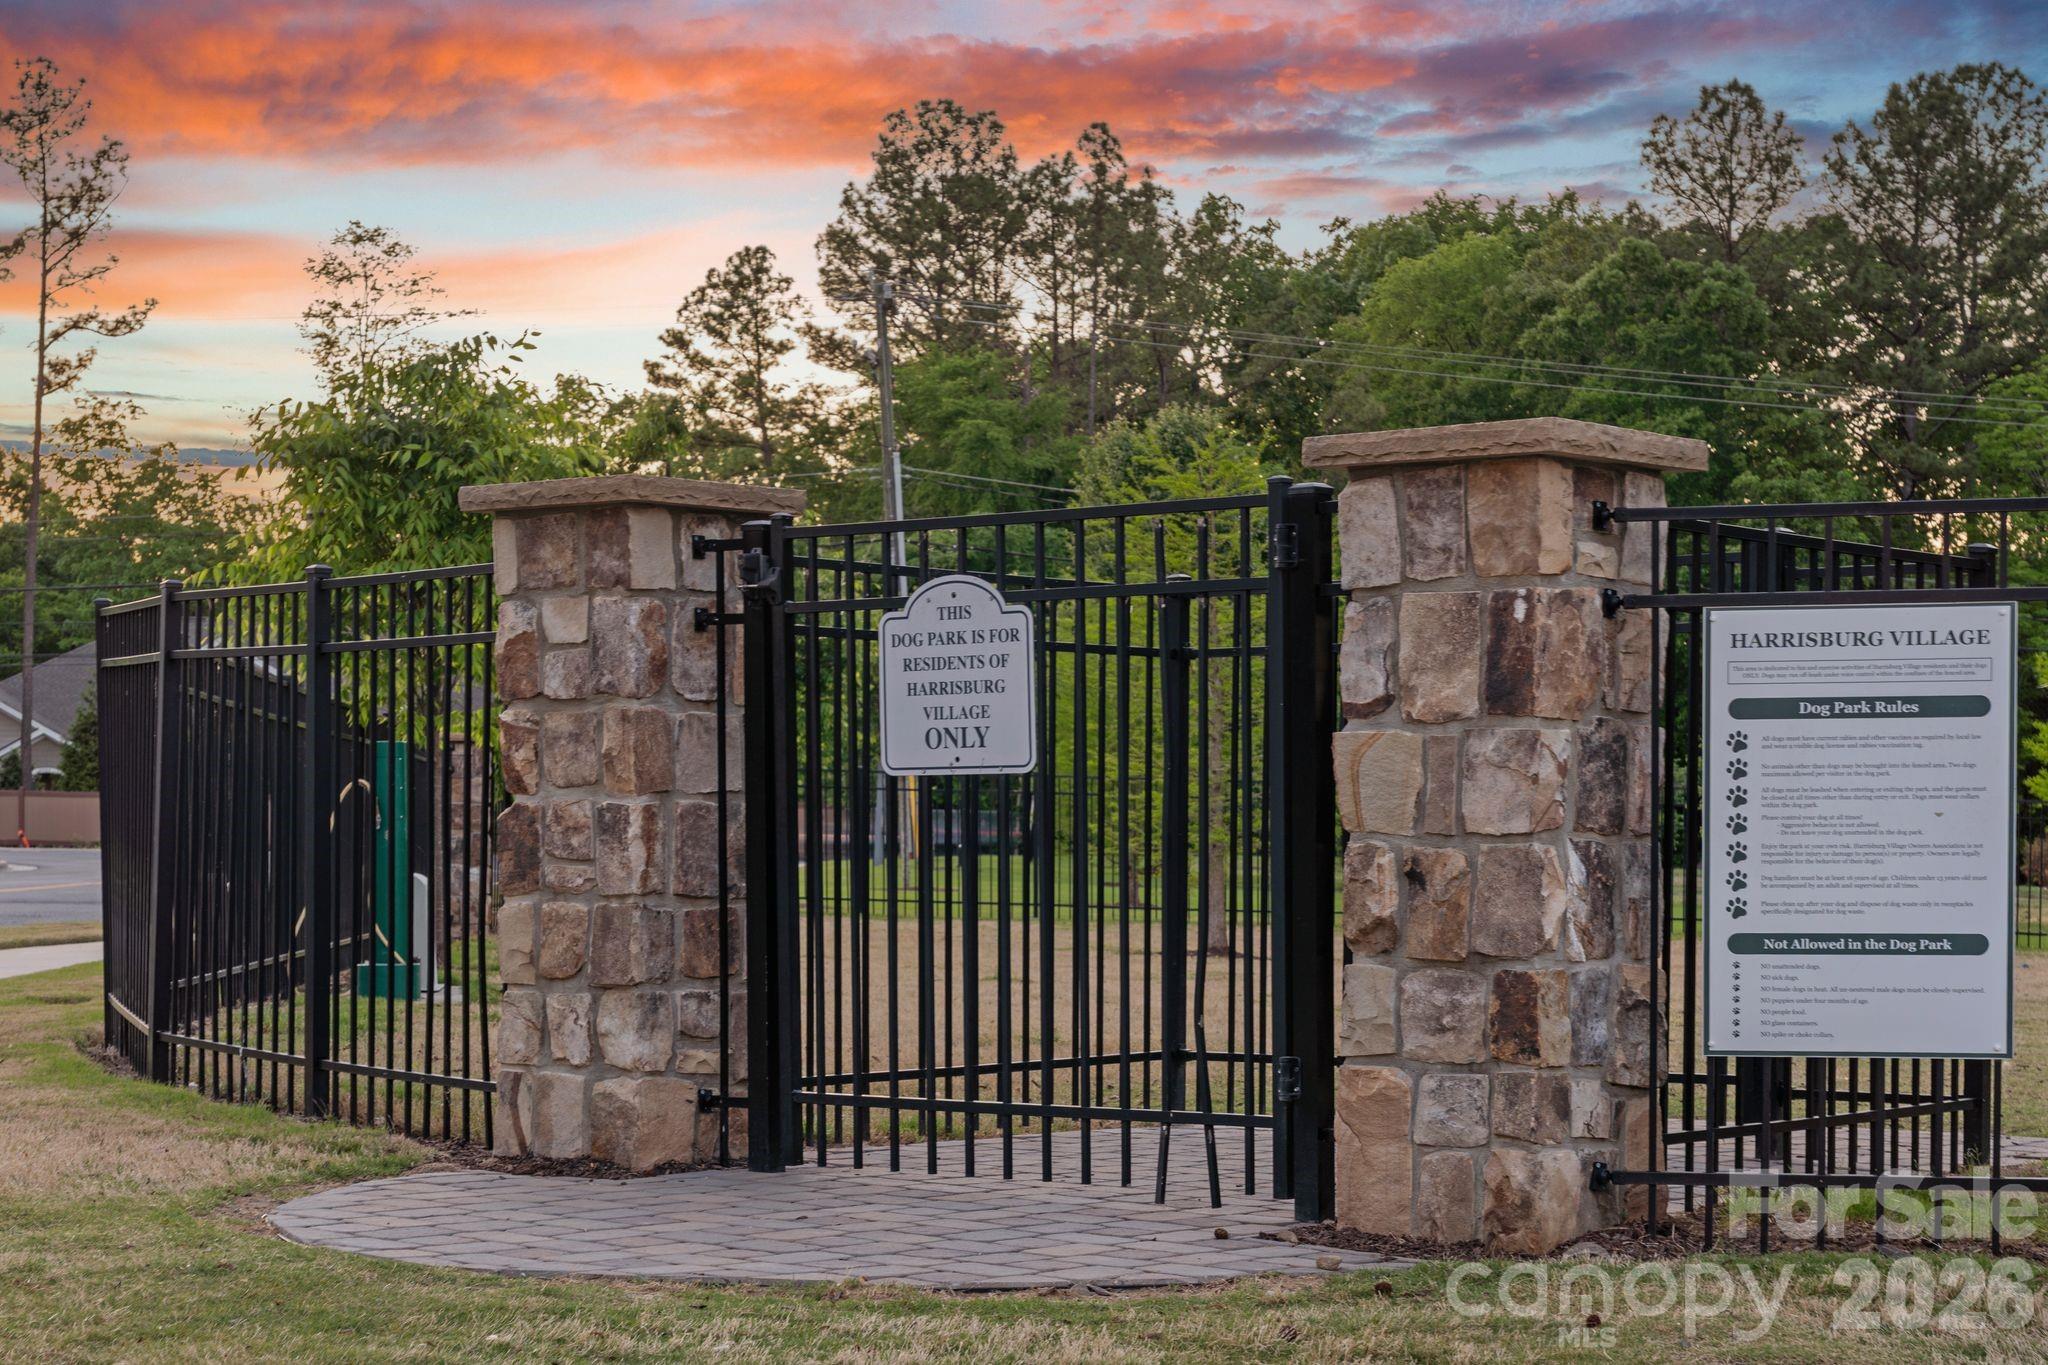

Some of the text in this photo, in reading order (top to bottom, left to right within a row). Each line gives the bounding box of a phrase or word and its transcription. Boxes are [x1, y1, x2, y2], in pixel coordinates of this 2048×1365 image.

[937, 605, 972, 620] THIS
[891, 628, 1021, 648] DOG PARK IS FOR
[1730, 628, 1991, 649] HARRISBURG VILLAGE
[903, 653, 1010, 672] RESIDENTS OF
[907, 679, 1006, 696] HARRISBURG
[922, 705, 991, 720] VILLAGE
[1798, 700, 1919, 716] Dog Park Rules
[925, 726, 990, 749] ONLY
[1764, 938, 1952, 952] Not Allowed in the Dog Park
